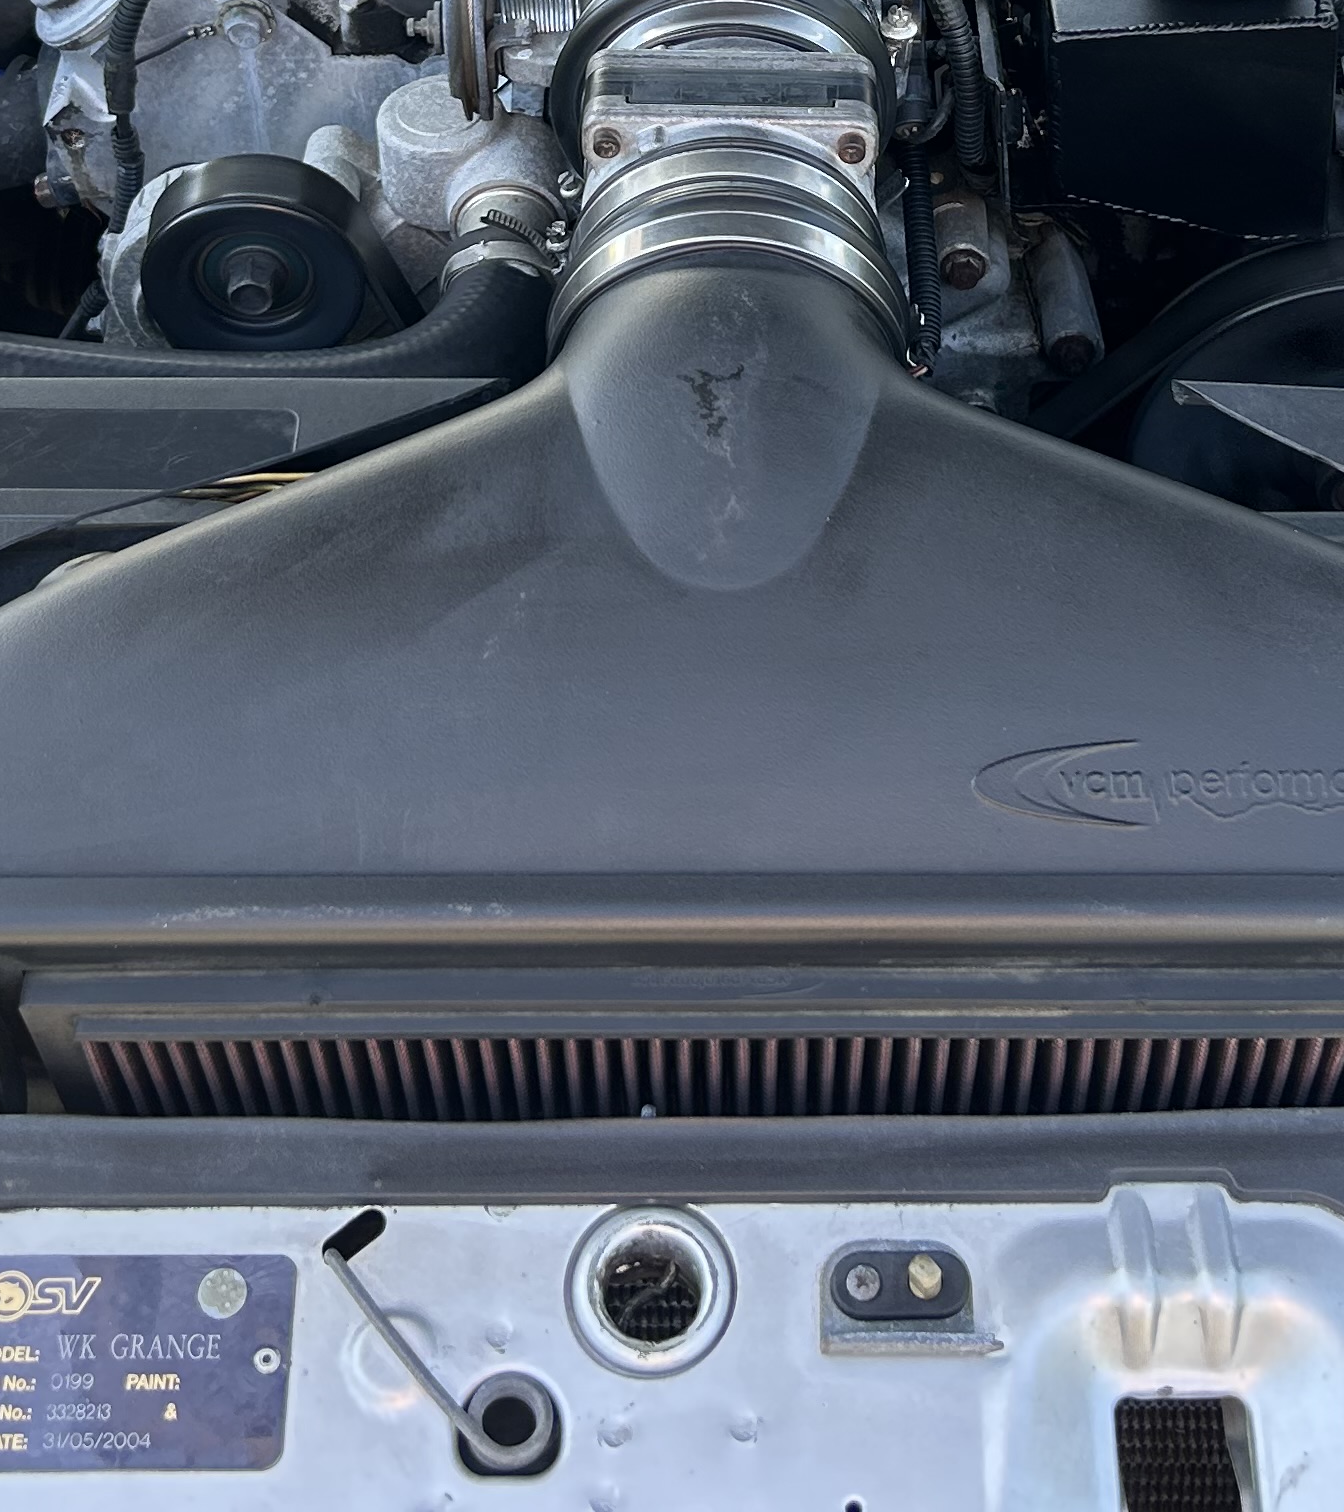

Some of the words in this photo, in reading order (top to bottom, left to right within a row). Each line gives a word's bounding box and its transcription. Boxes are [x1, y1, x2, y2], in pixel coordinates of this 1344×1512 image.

[57, 1333, 97, 1361] WK
[111, 1332, 222, 1361] GRANGE
[2, 1374, 37, 1392] No.:
[50, 1372, 95, 1391] 0199
[125, 1373, 181, 1391] PAINT:
[46, 1402, 113, 1422] 3328213
[163, 1401, 179, 1422] &
[42, 1430, 152, 1451] 31/05/2004
